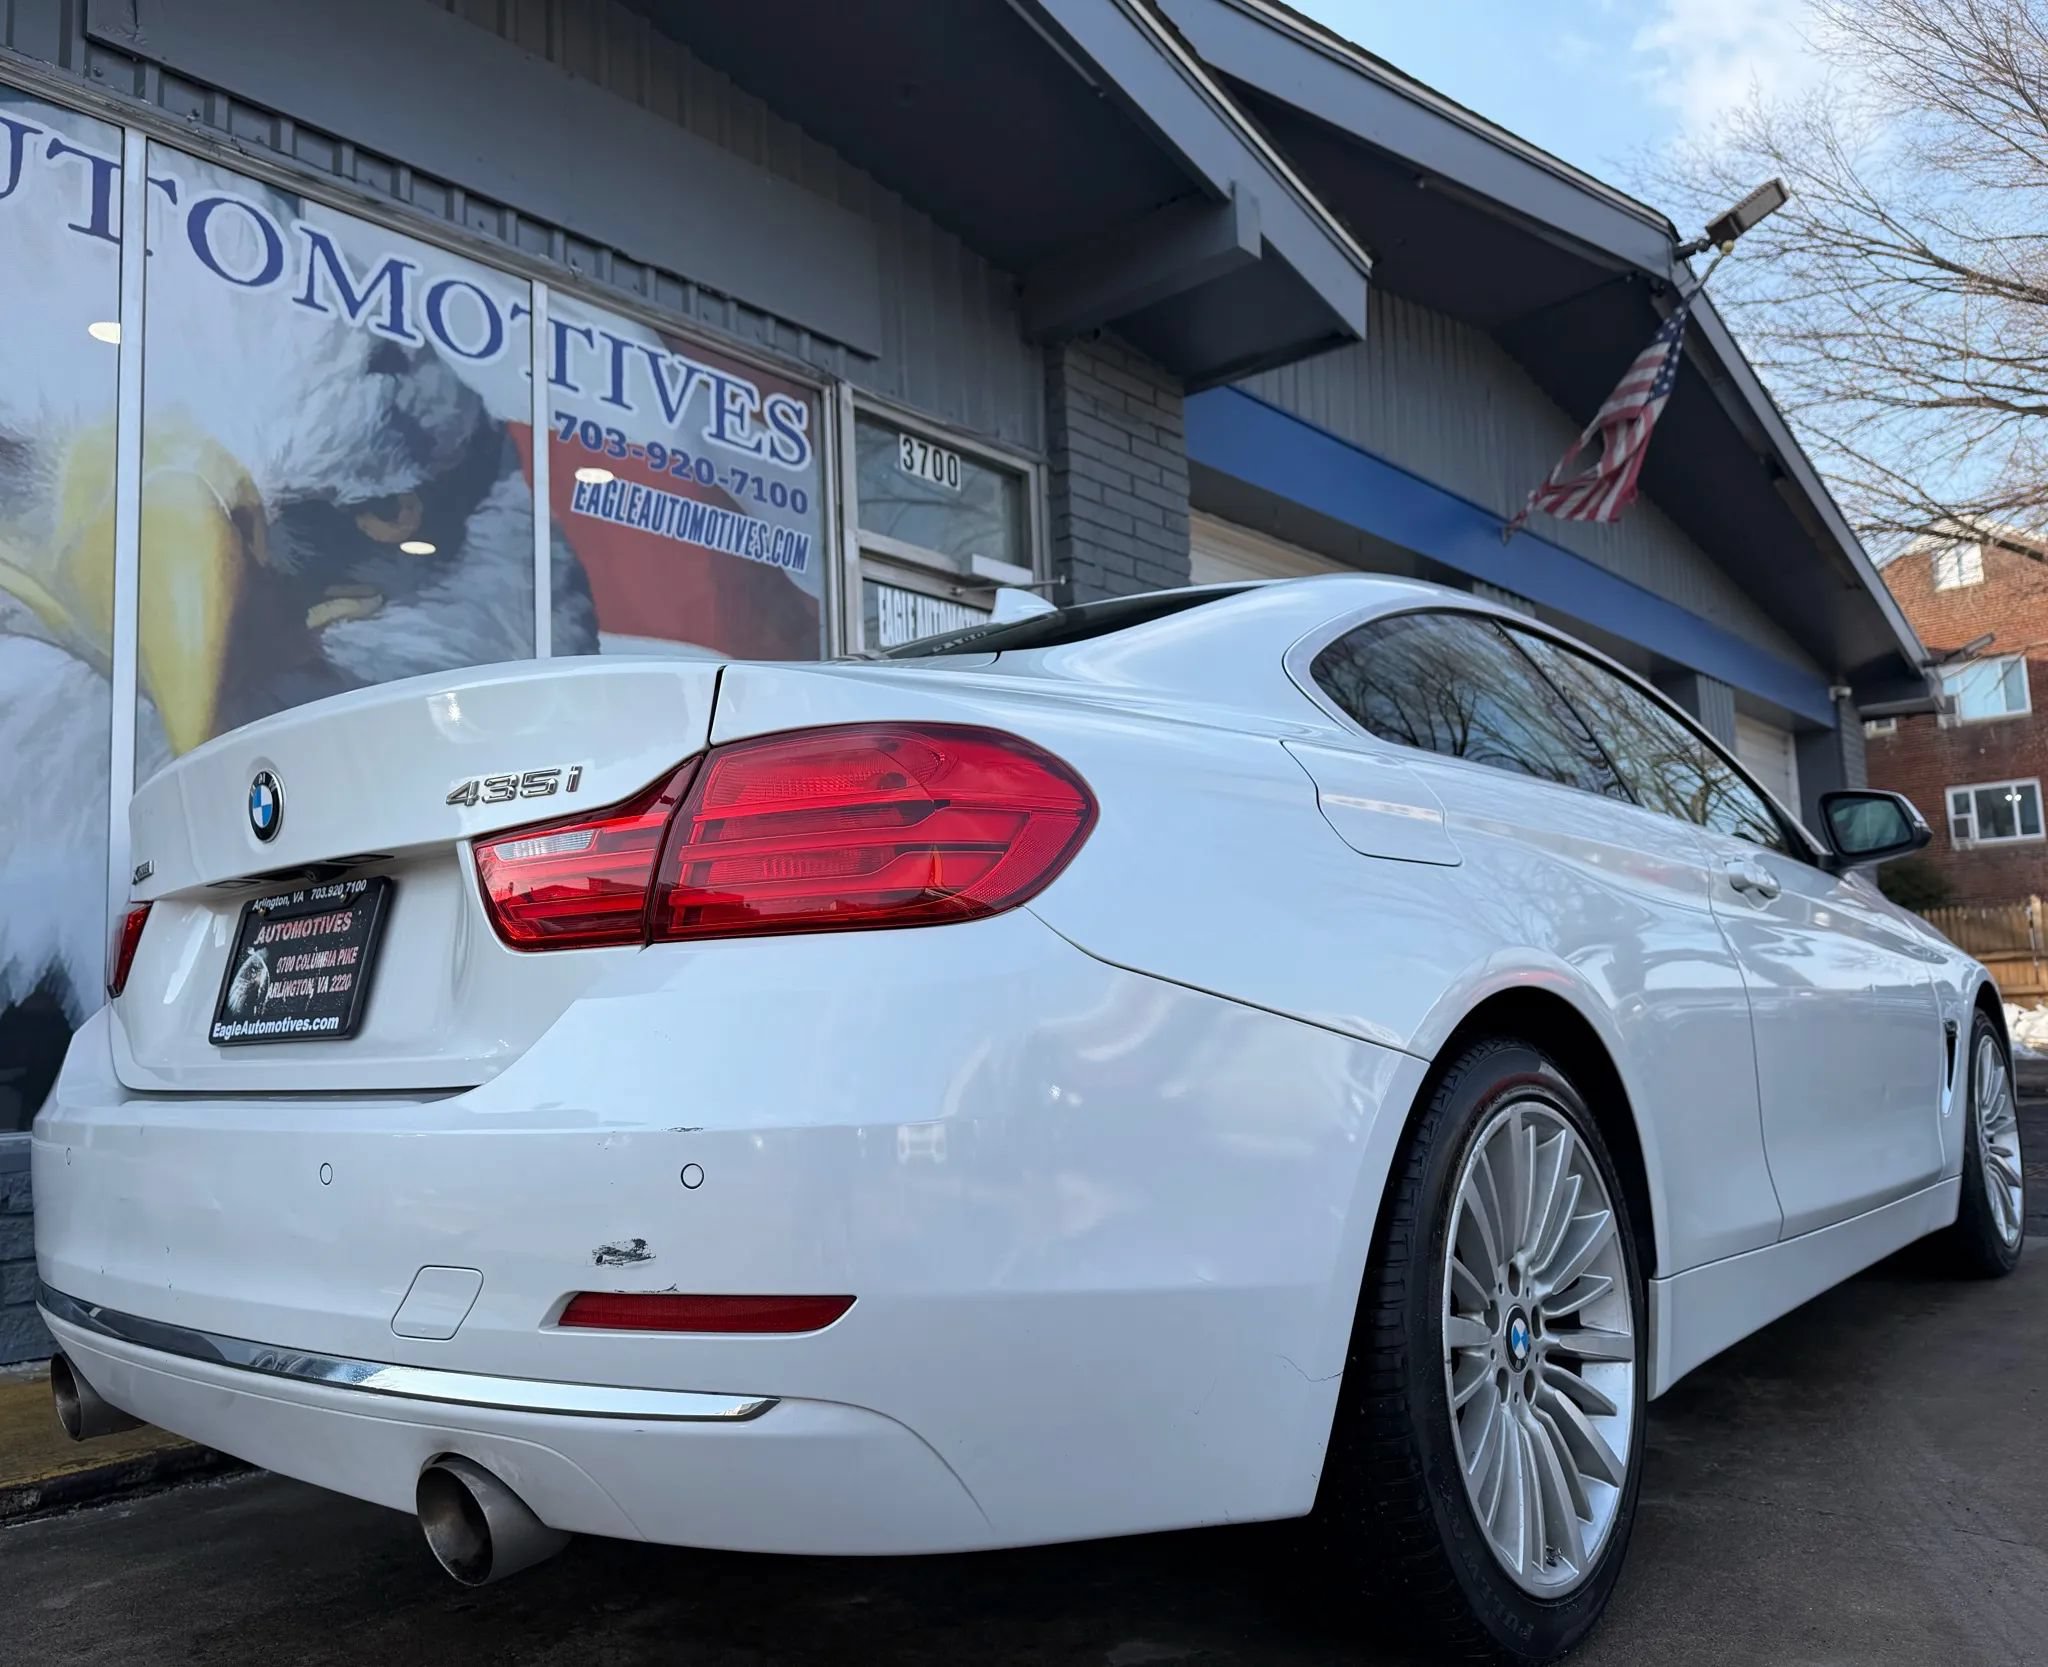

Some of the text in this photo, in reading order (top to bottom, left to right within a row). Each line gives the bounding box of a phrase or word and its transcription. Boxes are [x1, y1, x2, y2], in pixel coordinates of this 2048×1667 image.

[554, 410, 808, 515] 703-920-7100
[903, 437, 958, 488] 3700
[573, 479, 809, 571] EAGLEAUTOMOTIVES.COM
[446, 766, 583, 806] 435i
[252, 896, 290, 911] Arlington,
[293, 891, 304, 903] VA
[253, 911, 353, 945] AUTOMOTIVES
[295, 949, 336, 972] COLUMBIA
[337, 946, 359, 965] PIKE
[317, 976, 329, 994] VA
[212, 1016, 340, 1040] EagleAutomotives.com
